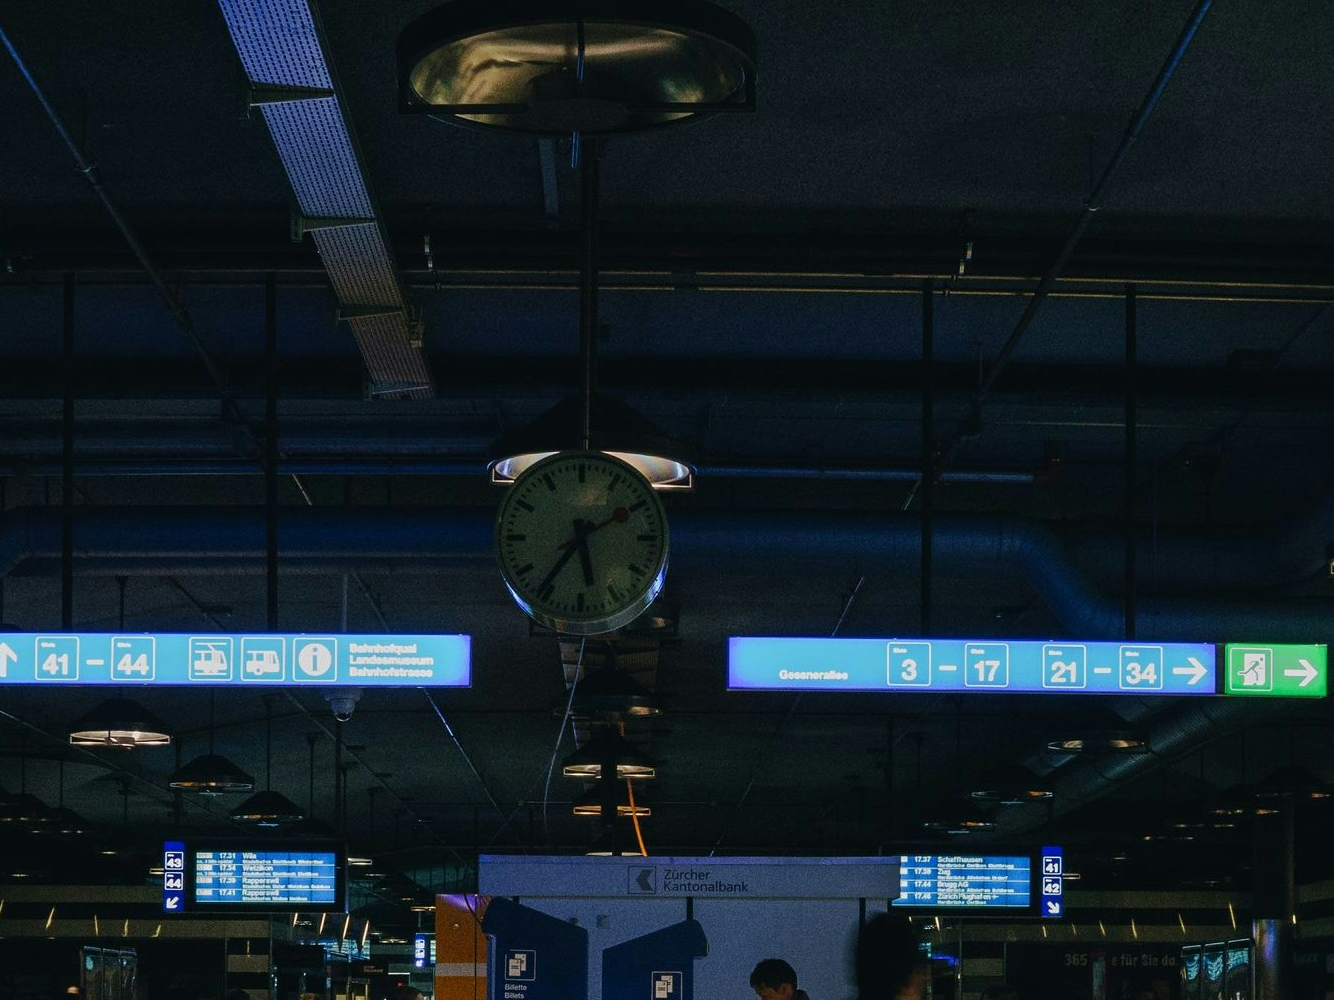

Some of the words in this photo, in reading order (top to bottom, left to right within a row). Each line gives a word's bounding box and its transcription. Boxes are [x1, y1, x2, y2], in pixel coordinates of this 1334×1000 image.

[349, 643, 417, 655] Bahnhofquai
[42, 653, 68, 675] 41
[117, 653, 149, 675] 44
[349, 655, 434, 666] Landesmuseum
[349, 666, 434, 678] Bahnhofstrasse
[779, 669, 849, 681] Gessnerallee
[901, 658, 917, 681] 3
[973, 660, 1000, 682] 17
[1050, 661, 1077, 683] 21
[1126, 662, 1157, 684] 34
[166, 858, 182, 868] 43
[1045, 863, 1059, 873] 41
[664, 869, 710, 880] Zürcher
[937, 868, 951, 876] Zug
[166, 878, 182, 888] 44
[663, 881, 748, 893] Kantonalbank
[937, 881, 957, 889] Brugg
[1044, 883, 1060, 893] 42
[1064, 953, 1088, 967] 365
[1120, 952, 1139, 967] für
[1141, 953, 1159, 967] Sie
[504, 983, 527, 991] Billette
